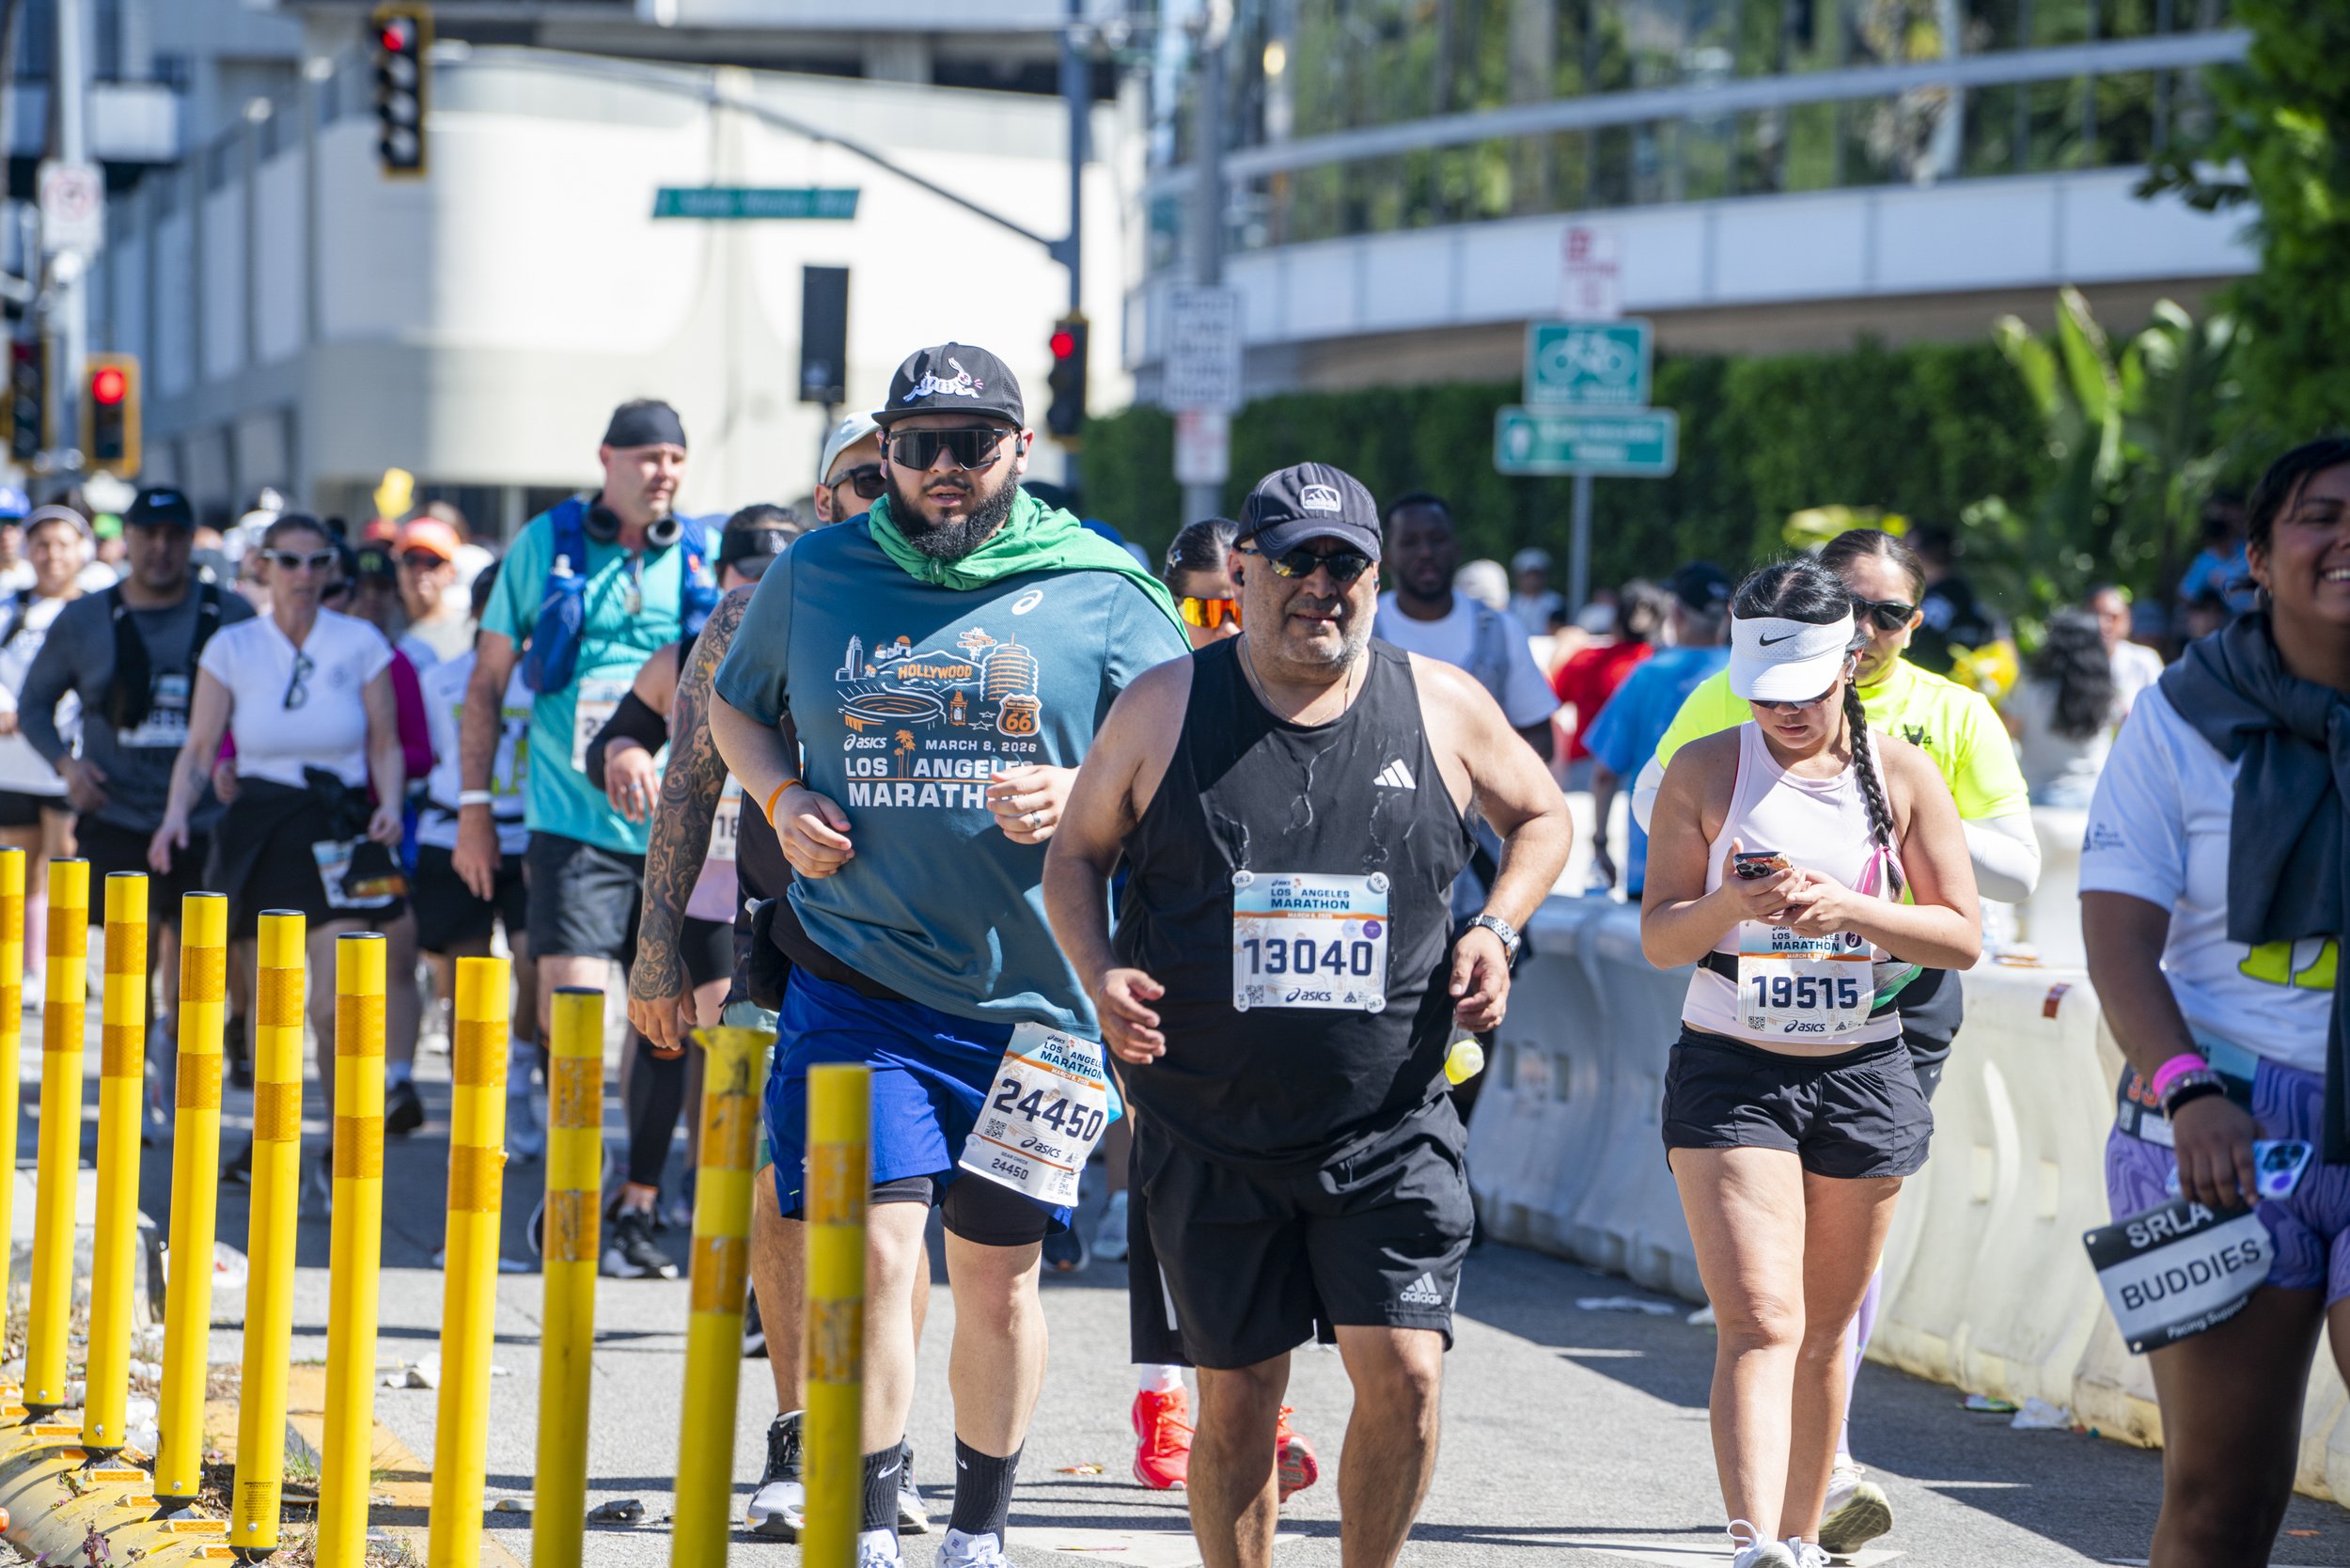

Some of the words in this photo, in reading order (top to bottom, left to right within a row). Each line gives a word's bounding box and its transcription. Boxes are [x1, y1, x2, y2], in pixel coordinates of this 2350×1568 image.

[898, 663, 972, 680] HOLLYWOOD
[1006, 713, 1031, 731] 66
[855, 737, 887, 749] asics
[925, 739, 978, 751] MARCH
[983, 740, 995, 753] 8,
[1001, 742, 1038, 753] 2026
[844, 757, 888, 777] LOS
[913, 758, 1034, 779] ANGEL
[848, 782, 1026, 809] MARATH
[1271, 887, 1292, 897] LOS
[1301, 888, 1350, 899] ANGELES
[1271, 899, 1350, 910] MARATHON
[1772, 940, 1840, 951] MARATHON
[1244, 939, 1372, 976] 13040
[1301, 991, 1332, 1002] asics
[1751, 975, 1858, 1010] 19515
[1797, 1022, 1826, 1033] asics
[1040, 1050, 1103, 1080] MARATHON
[1043, 1041, 1063, 1054] LOS
[1070, 1051, 1103, 1069] ANGELE
[993, 1077, 1104, 1142] 24450
[1034, 1142, 1062, 1159] asics
[992, 1157, 1029, 1181] 24450
[2126, 1201, 2215, 1249] SRLA
[2120, 1238, 2261, 1311] BUDDIES
[1400, 1292, 1442, 1305] adidas
[2166, 1316, 2206, 1340] Pacing
[2205, 1294, 2249, 1325] Support
